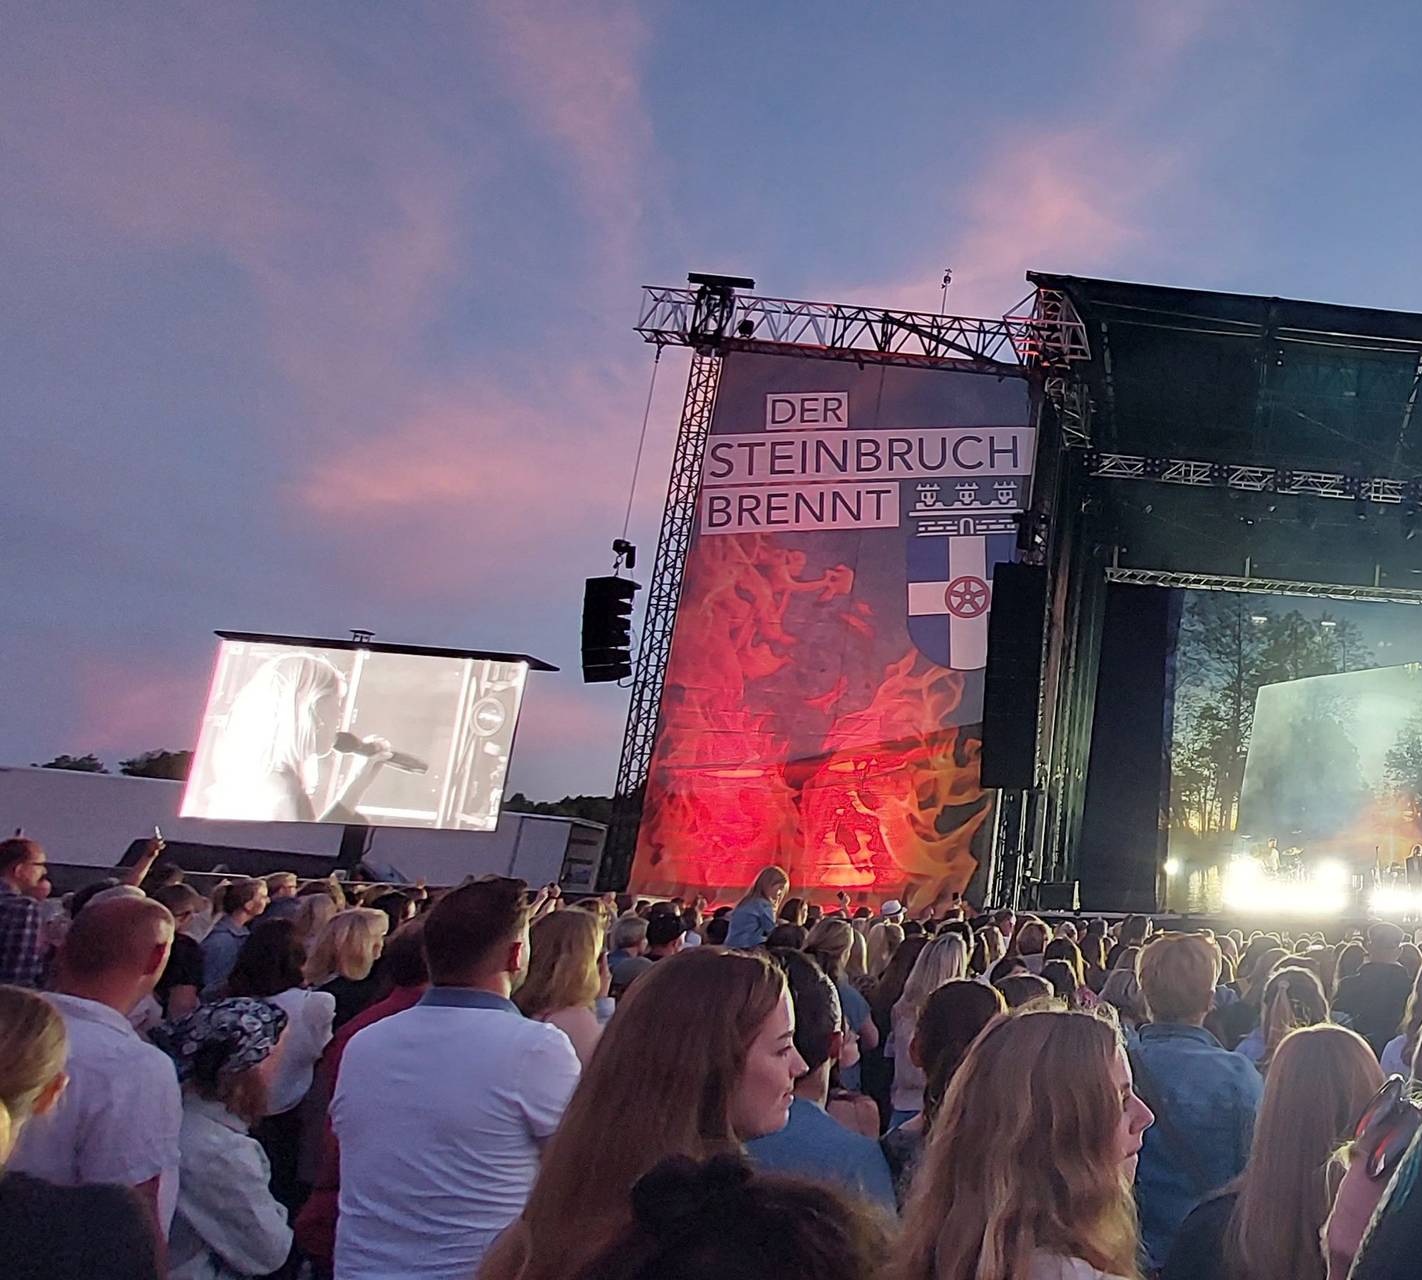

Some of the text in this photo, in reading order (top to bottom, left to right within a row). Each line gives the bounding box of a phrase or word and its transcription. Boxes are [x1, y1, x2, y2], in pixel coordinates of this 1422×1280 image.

[770, 397, 844, 425] DER
[709, 435, 1019, 479] STEINBRUCH
[707, 489, 892, 528] BRENNT
